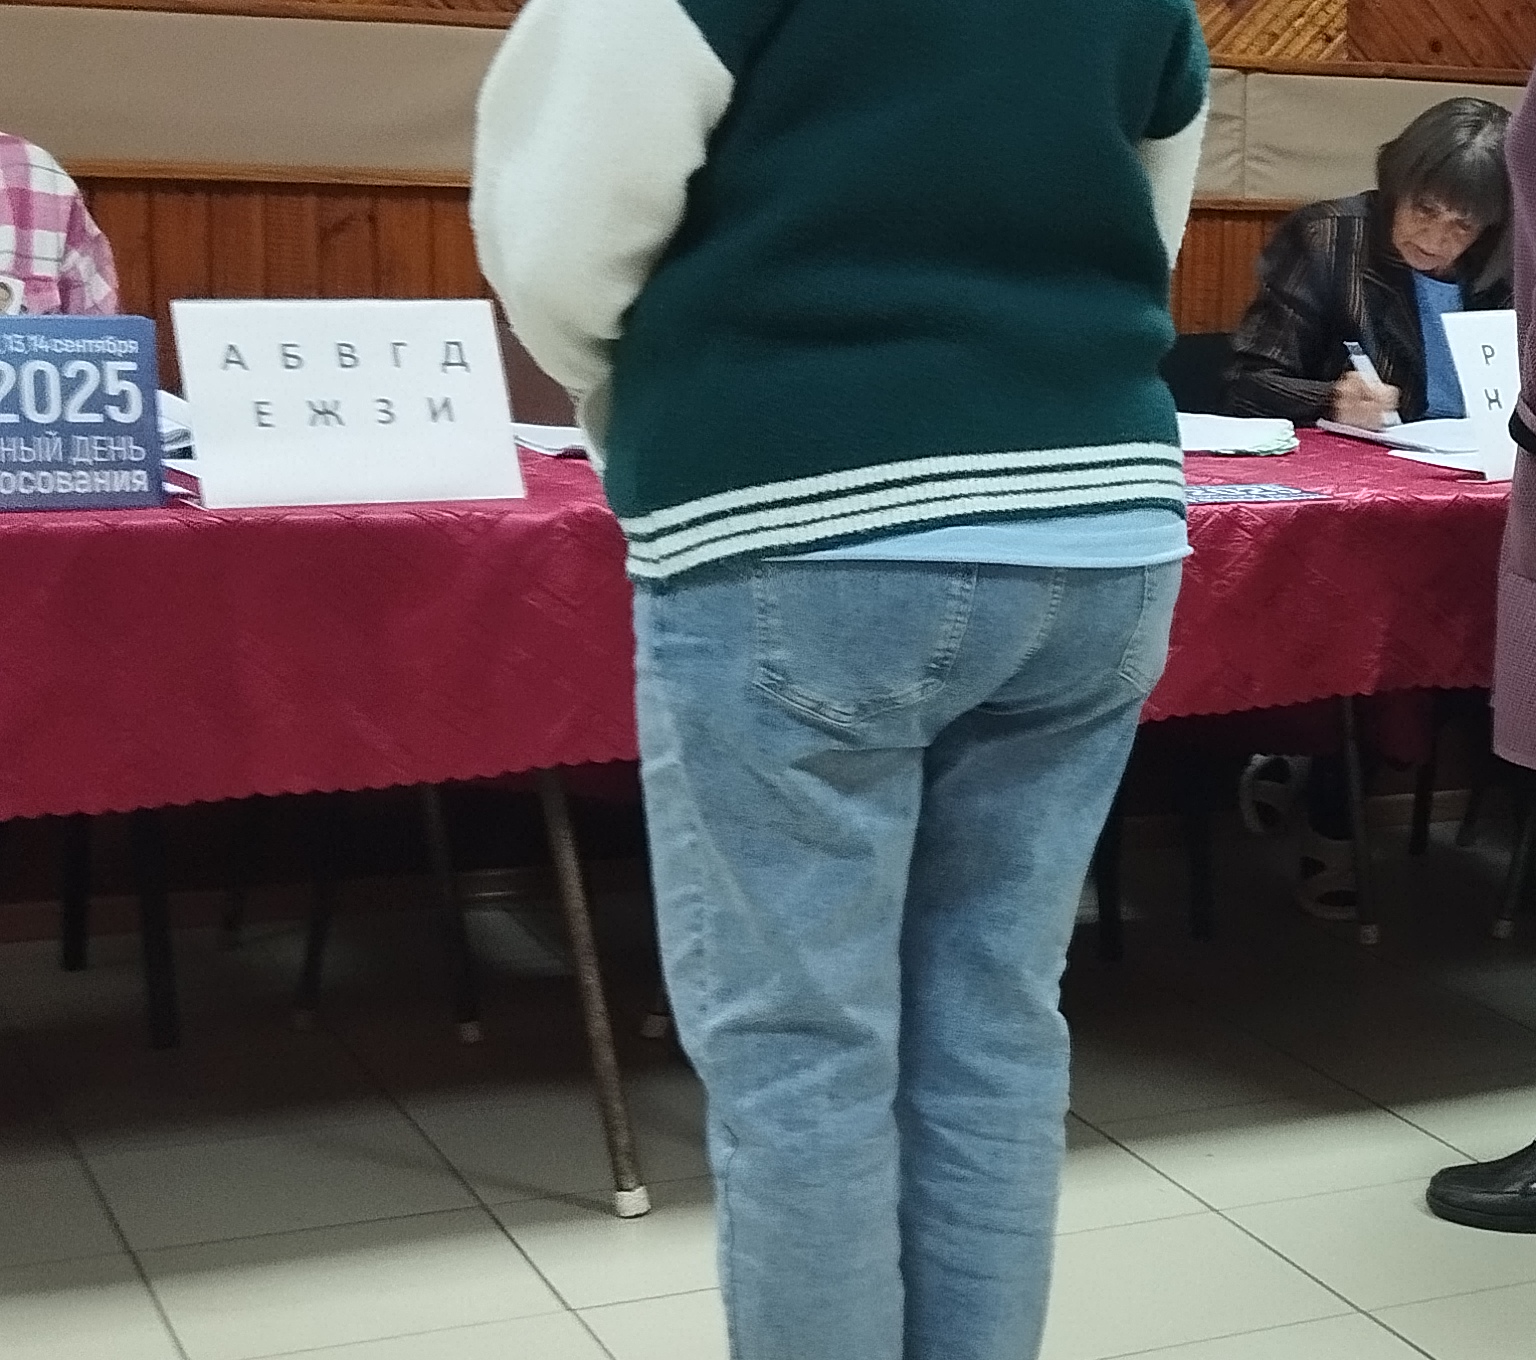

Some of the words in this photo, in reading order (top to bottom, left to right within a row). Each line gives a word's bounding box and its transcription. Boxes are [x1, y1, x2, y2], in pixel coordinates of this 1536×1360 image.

[219, 344, 250, 371] А
[280, 343, 304, 369] Б
[336, 342, 360, 368] В
[390, 342, 408, 368] Г
[440, 341, 471, 373] Д
[1481, 344, 1496, 367] Р
[253, 400, 276, 428] Е
[304, 399, 346, 427] Ж
[374, 398, 396, 425] З
[424, 397, 455, 423] И
[70, 435, 146, 465] ДЕНЬ
